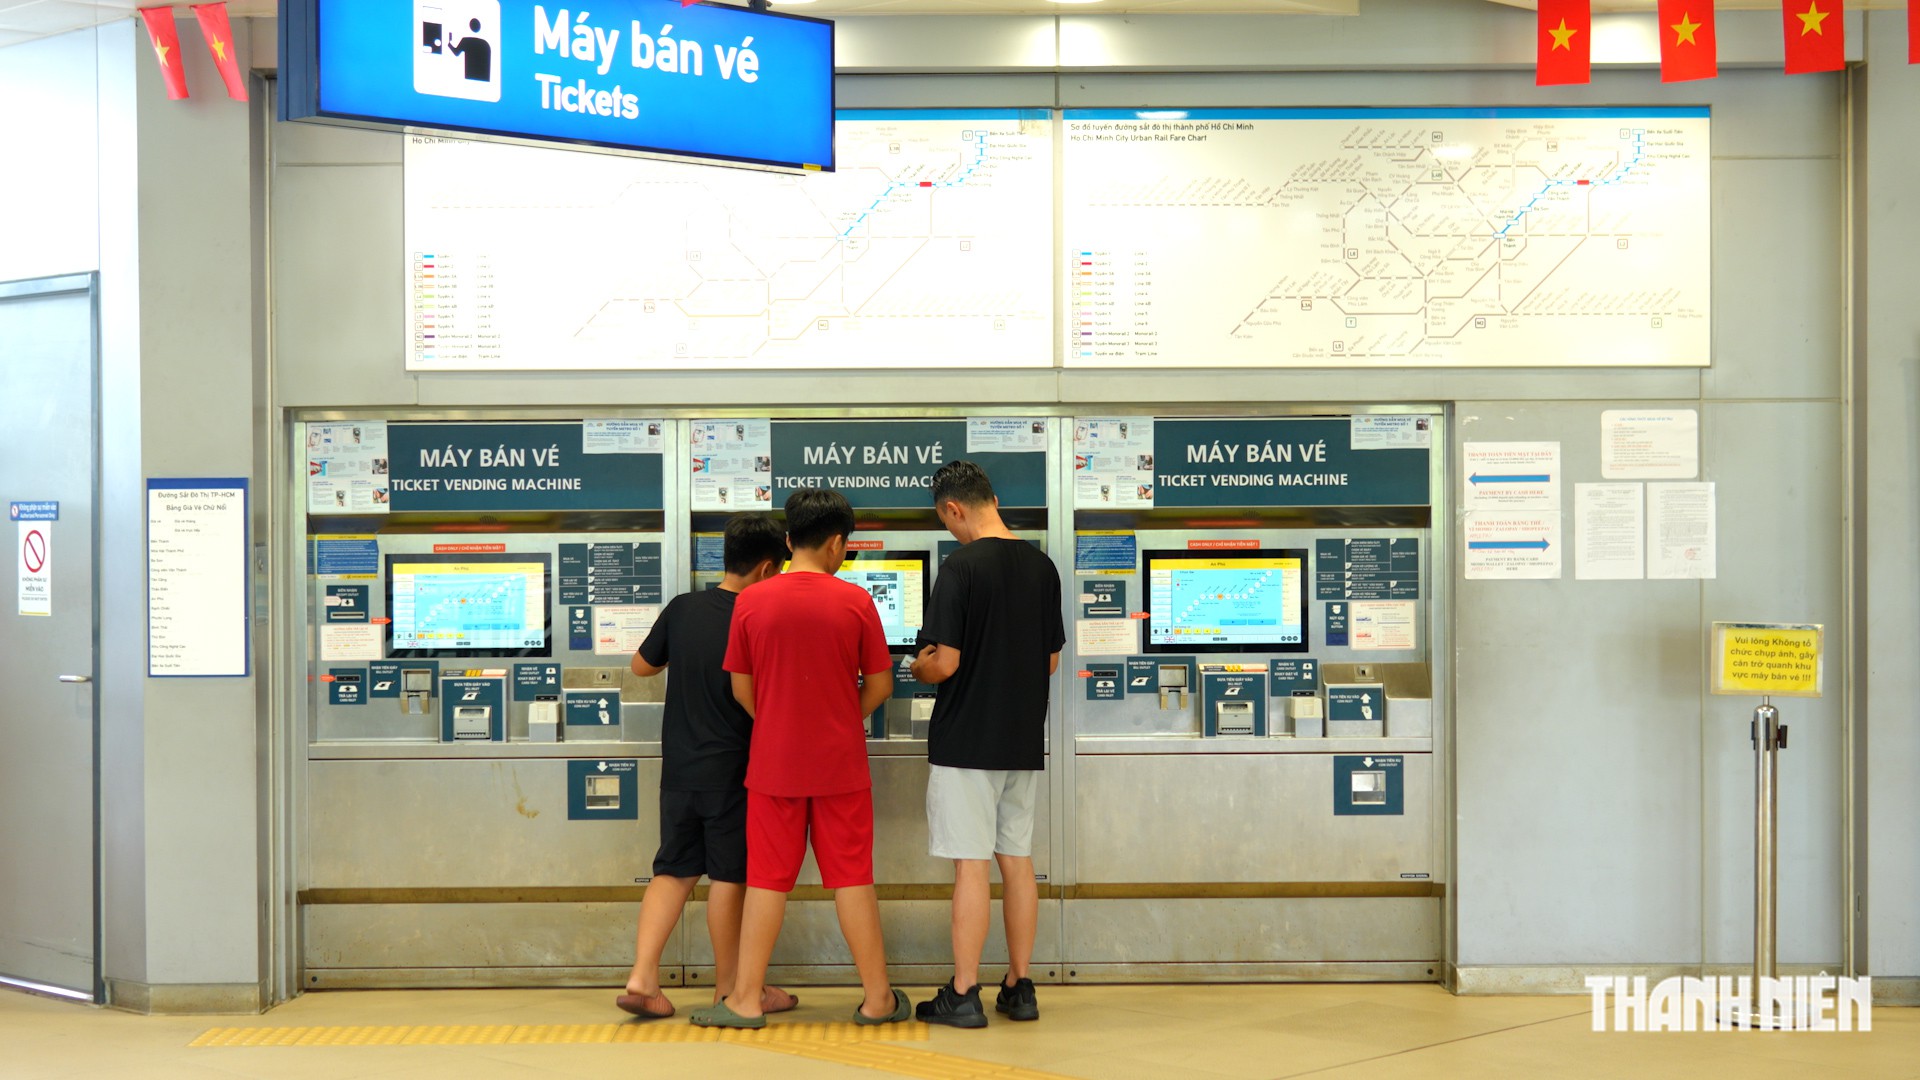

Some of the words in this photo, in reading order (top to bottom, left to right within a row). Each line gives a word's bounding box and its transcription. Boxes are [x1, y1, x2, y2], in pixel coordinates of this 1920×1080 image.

[534, 5, 619, 76] Máy
[631, 20, 704, 76] bán
[714, 36, 760, 83] vé
[535, 73, 640, 120] Tickets
[1070, 134, 1082, 142] Ho
[1083, 134, 1095, 142] Chi
[1096, 134, 1115, 142] Minh
[1116, 134, 1130, 142] City
[1131, 134, 1154, 142] Urban
[1155, 134, 1169, 142] Rail
[1170, 134, 1187, 142] Fare
[1188, 134, 1207, 142] Chart
[420, 444, 472, 468] MÁY
[480, 444, 528, 468] BÁN
[532, 444, 560, 467] VÉ
[804, 442, 856, 465] MÁY
[863, 442, 912, 465] BÁN
[916, 441, 943, 464] VÉ
[1187, 440, 1240, 463] MÁY
[1247, 440, 1292, 463] BÁN
[1299, 440, 1326, 463] VÉ
[392, 479, 438, 491] TICKET
[444, 479, 507, 491] VENDING
[512, 478, 582, 490] MACHINE
[776, 476, 823, 488] TICKET
[828, 476, 890, 488] VENDING
[1159, 475, 1206, 487] TICKET
[1211, 475, 1274, 487] VENDING
[1278, 474, 1348, 486] MACHINE
[1751, 638, 1769, 647] lòng
[1772, 638, 1800, 648] Không
[1730, 648, 1752, 656] chức
[1755, 650, 1776, 659] chụp
[1799, 652, 1815, 661] gây
[1766, 662, 1793, 671] quanh
[1796, 662, 1812, 671] khu
[1732, 672, 1749, 680] vực
[1751, 672, 1769, 681] máy
[1772, 672, 1787, 680] bán
